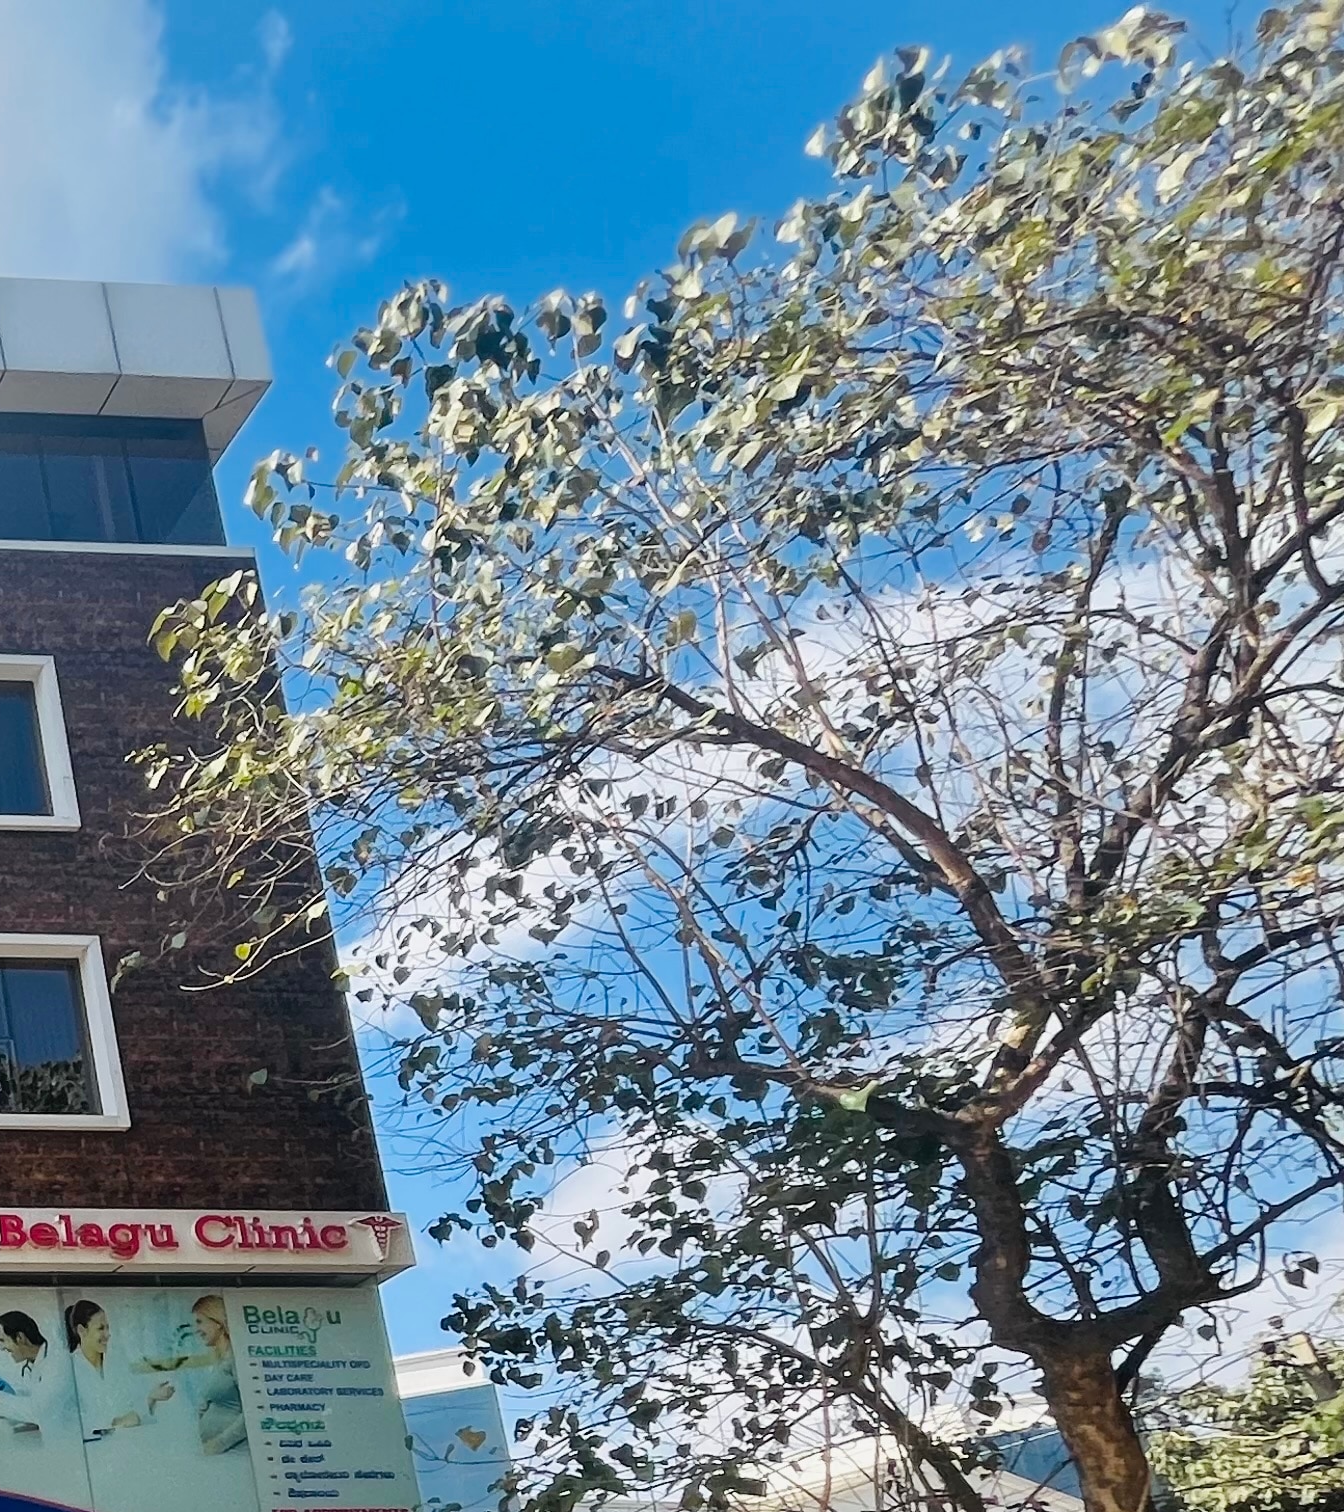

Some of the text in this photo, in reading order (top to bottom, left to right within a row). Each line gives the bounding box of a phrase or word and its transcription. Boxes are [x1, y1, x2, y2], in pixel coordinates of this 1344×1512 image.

[194, 1215, 348, 1251] Clinic
[248, 1345, 317, 1357] FACILITIES
[264, 1374, 313, 1382] DAY CARE
[267, 1388, 333, 1396] LABORATORY
[269, 1403, 326, 1412] PHARMACY
